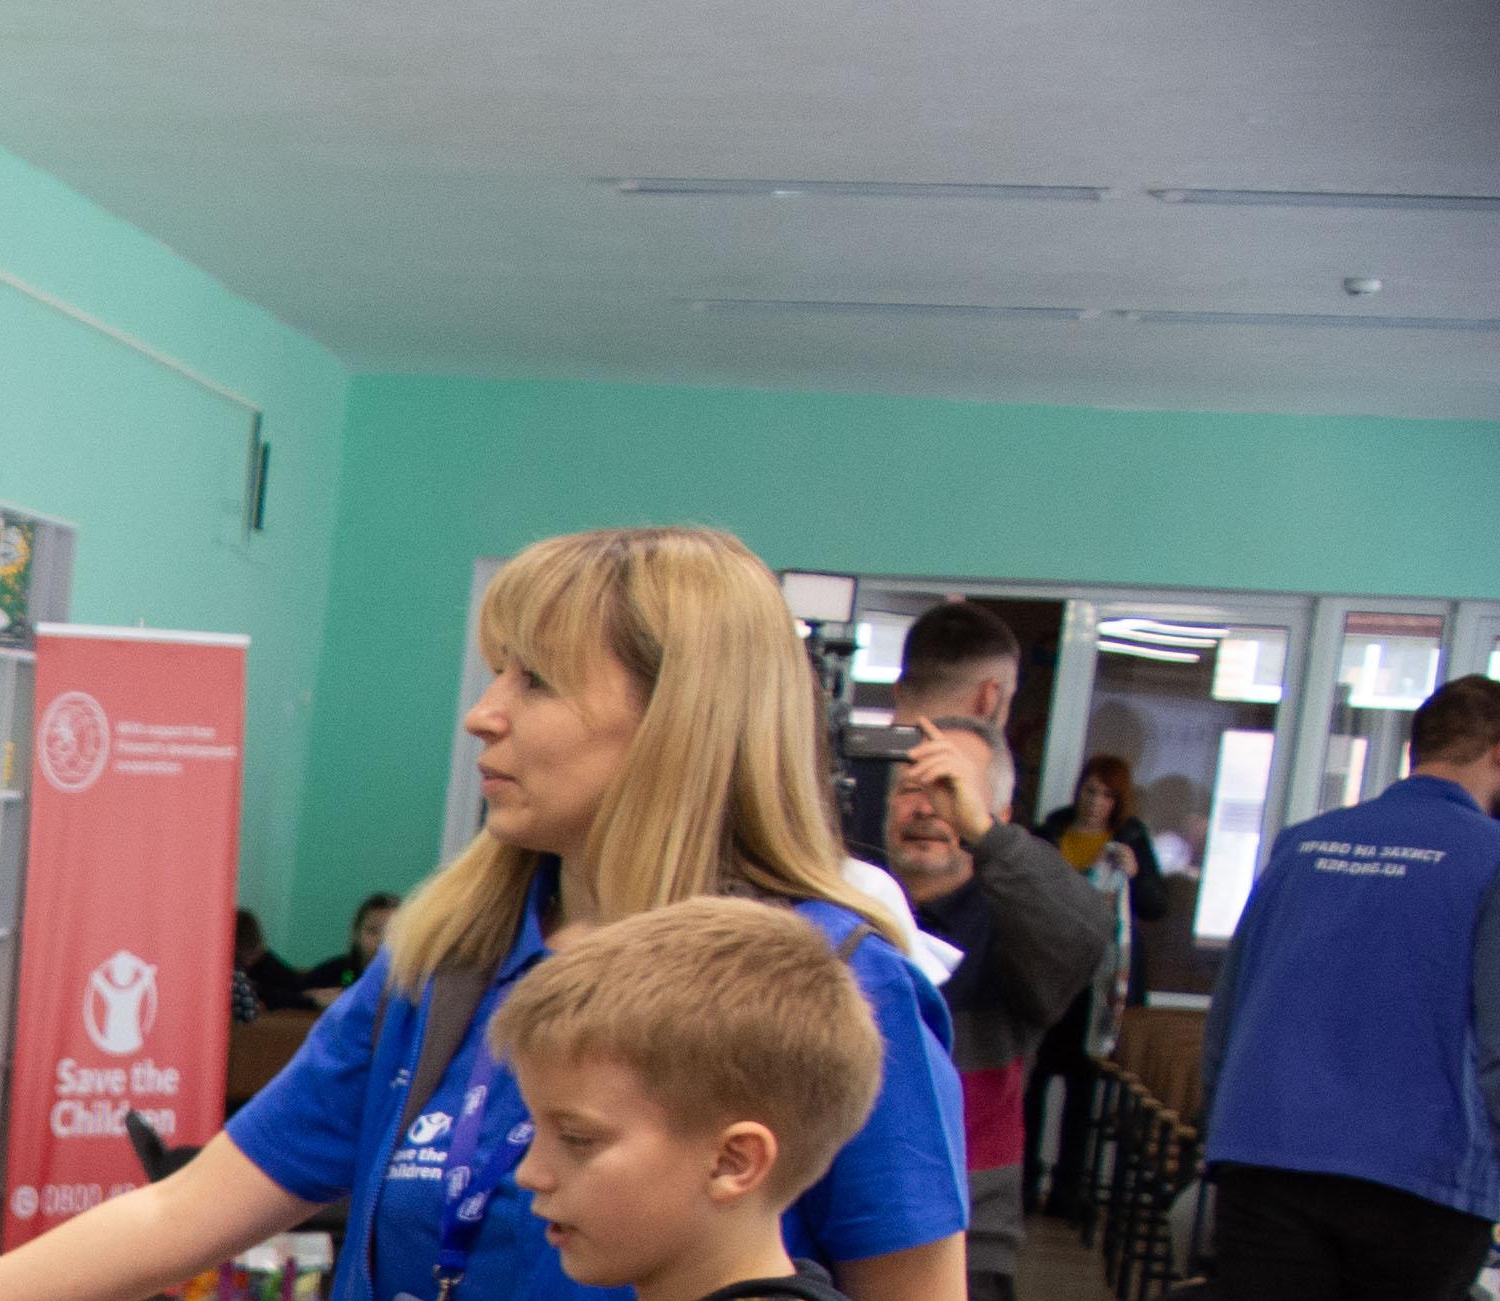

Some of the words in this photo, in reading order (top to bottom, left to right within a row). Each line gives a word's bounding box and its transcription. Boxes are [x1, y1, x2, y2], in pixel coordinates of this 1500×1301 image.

[56, 1058, 127, 1095] Save
[130, 1058, 180, 1096] the
[417, 1147, 448, 1162] the
